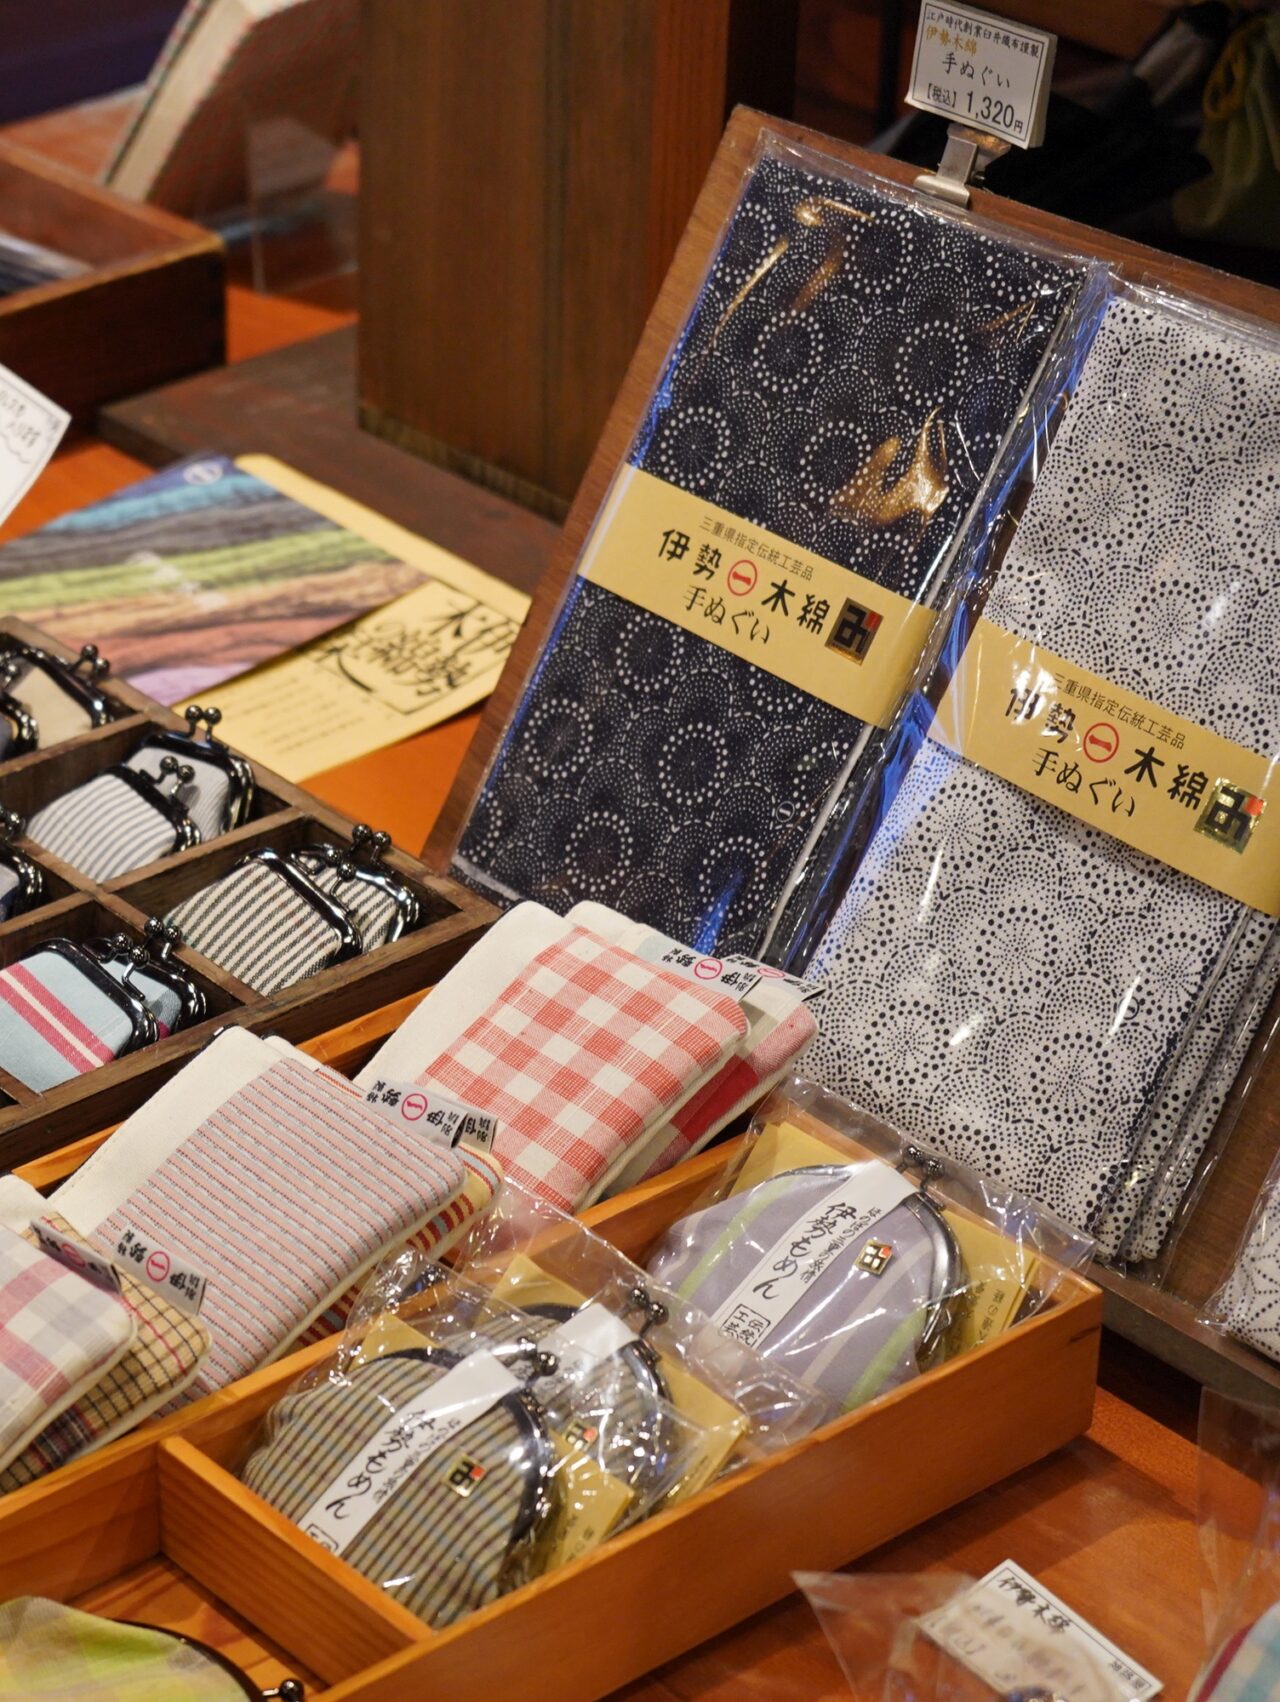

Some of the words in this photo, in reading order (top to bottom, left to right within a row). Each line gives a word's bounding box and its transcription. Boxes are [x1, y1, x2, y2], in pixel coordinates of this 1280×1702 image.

[926, 10, 1040, 58] 江戸時代創業臼井織布謹製
[926, 25, 977, 56] 伊勢木綿
[942, 52, 1010, 88] 手ぬぐい
[699, 516, 814, 581] 三重県指定伝統工芸品
[683, 585, 770, 644] 手ぬぐい
[1053, 672, 1186, 750] 三重県指定伝統工芸品
[1032, 748, 1135, 817] 手ぬぐい
[753, 1202, 858, 1301] 伊勢もめん
